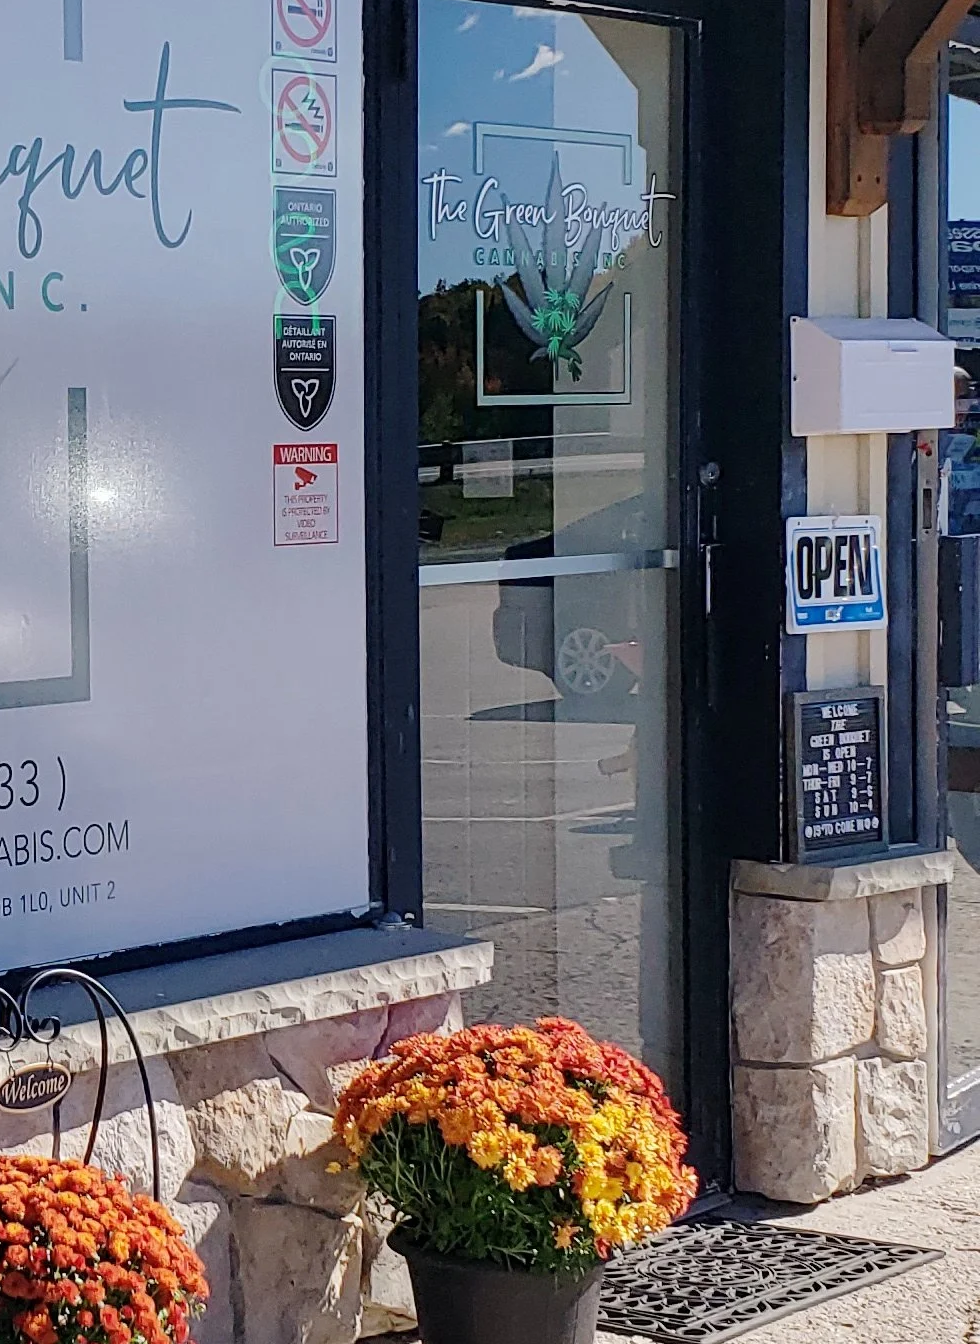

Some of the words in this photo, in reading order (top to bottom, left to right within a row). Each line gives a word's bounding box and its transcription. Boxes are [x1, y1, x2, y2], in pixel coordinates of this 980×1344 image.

[422, 169, 467, 240] The
[474, 176, 557, 242] Green
[561, 174, 677, 251] Bouquet
[317, 340, 327, 349] EN
[289, 352, 322, 361] ONTARIO
[280, 447, 332, 463] WARNING
[796, 534, 874, 600] OPEN
[821, 704, 859, 719] WELCOME
[810, 734, 835, 748] GREEN
[835, 746, 857, 759] OPEN
[815, 789, 837, 805] SAT
[815, 803, 838, 819] SUN
[59, 883, 101, 908] UNIT
[107, 881, 116, 900] 2
[2, 1075, 66, 1105] Welcome
